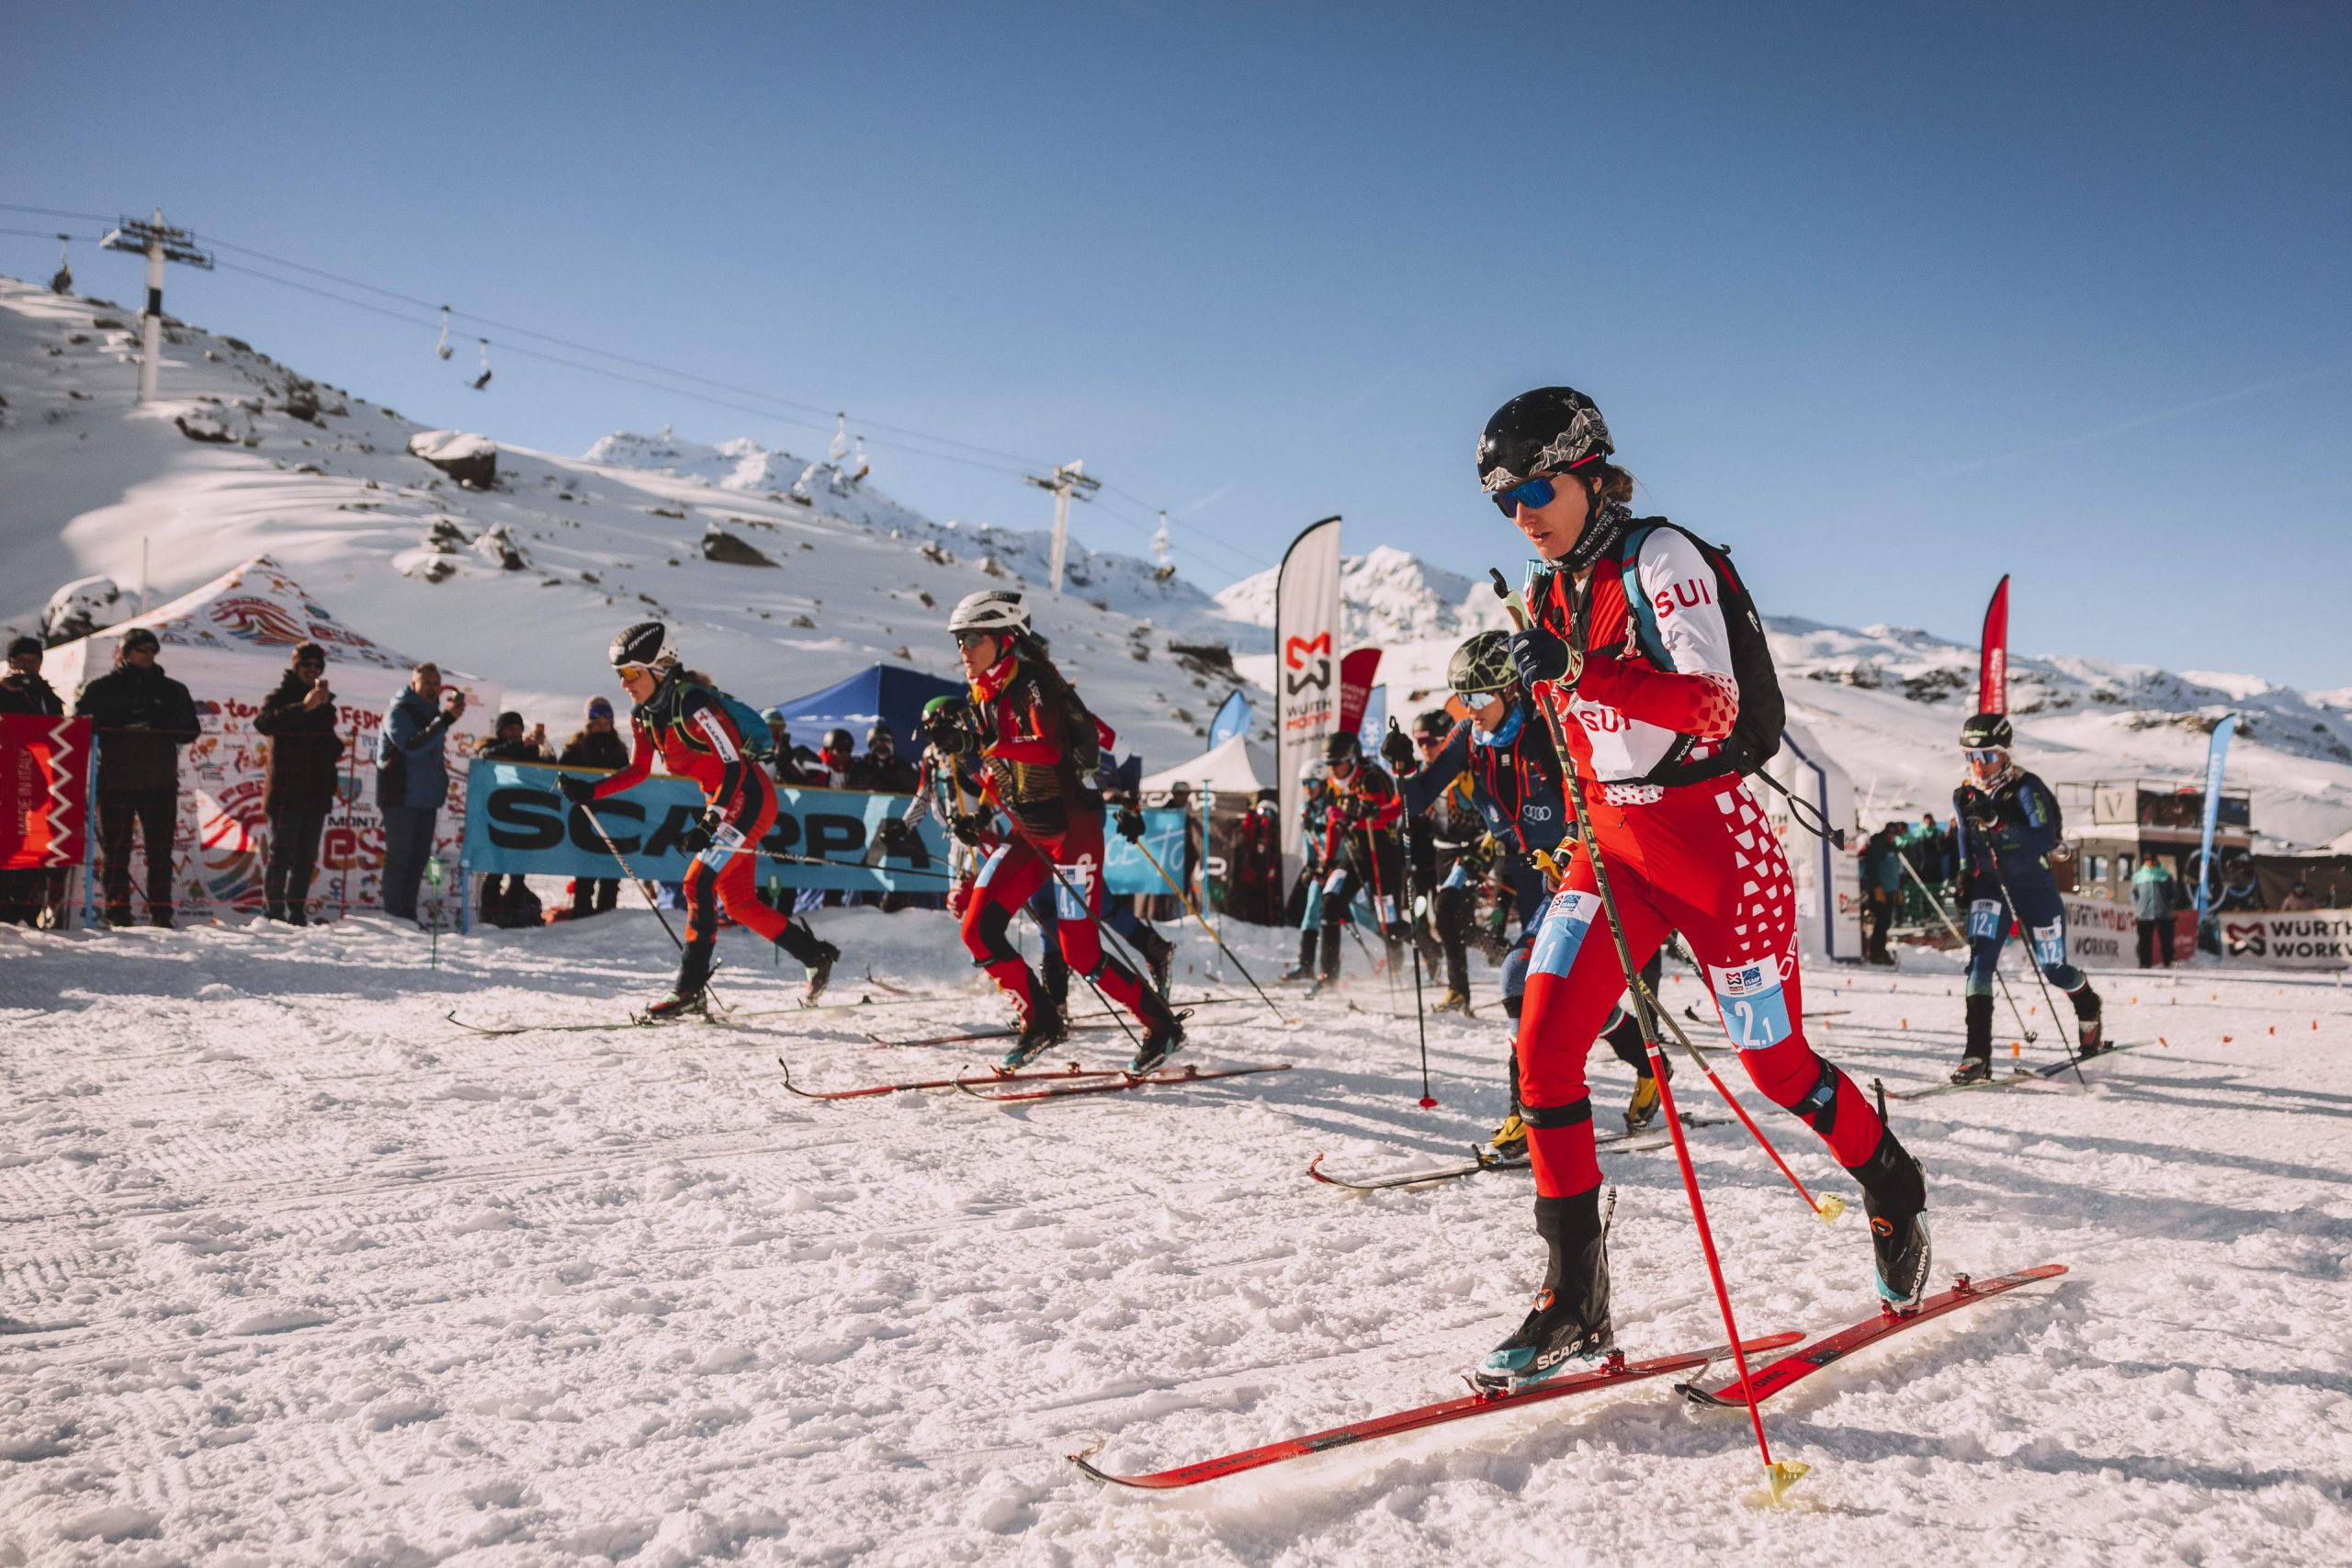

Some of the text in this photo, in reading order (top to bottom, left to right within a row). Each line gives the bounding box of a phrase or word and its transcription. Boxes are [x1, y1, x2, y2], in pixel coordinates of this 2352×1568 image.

[1655, 578, 1712, 619] SUI
[1745, 976, 1761, 987] ISMF
[1735, 1000, 1775, 1046] 2.1
[1909, 1245, 1928, 1296] SCARPA
[1537, 1332, 1600, 1371] SCARA
[1739, 1370, 1789, 1394] AOMIC
